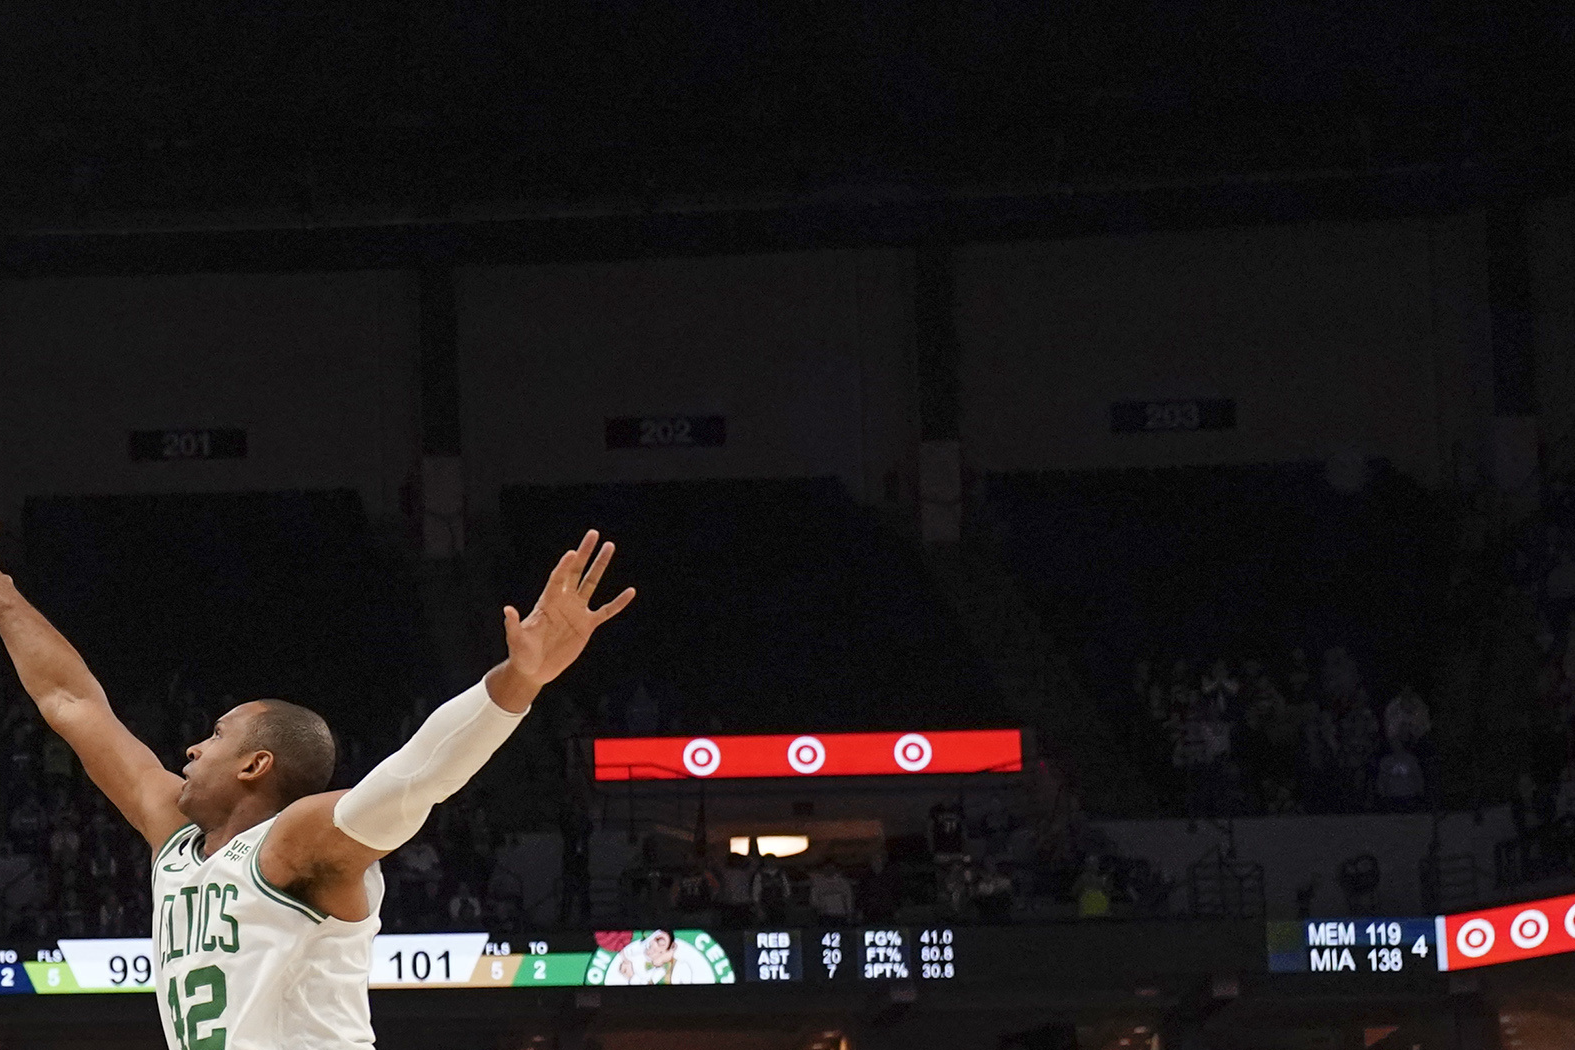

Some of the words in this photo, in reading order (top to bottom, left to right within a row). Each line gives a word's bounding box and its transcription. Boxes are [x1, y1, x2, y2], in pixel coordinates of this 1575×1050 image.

[639, 419, 693, 445] 202
[161, 433, 212, 458] 201
[756, 932, 790, 949] REB
[821, 932, 841, 948] 42
[864, 930, 902, 947] FG%
[920, 929, 953, 945] 41.0
[1307, 922, 1355, 946] MEM
[1365, 922, 1402, 945] 119
[1411, 934, 1428, 958] 4
[37, 949, 64, 963] FLS
[485, 942, 511, 956] FLS
[528, 941, 549, 955] TO
[757, 949, 790, 966] AST
[822, 948, 842, 965] 20
[866, 946, 902, 963] FT%
[1310, 949, 1356, 972] MIA
[1367, 948, 1403, 972] 138
[0, 967, 15, 987] 2
[109, 955, 152, 985] 99
[389, 949, 451, 981] 101
[533, 960, 547, 980] 2
[759, 965, 791, 981] STL
[827, 964, 838, 980] 7
[864, 962, 909, 979] 3PT%
